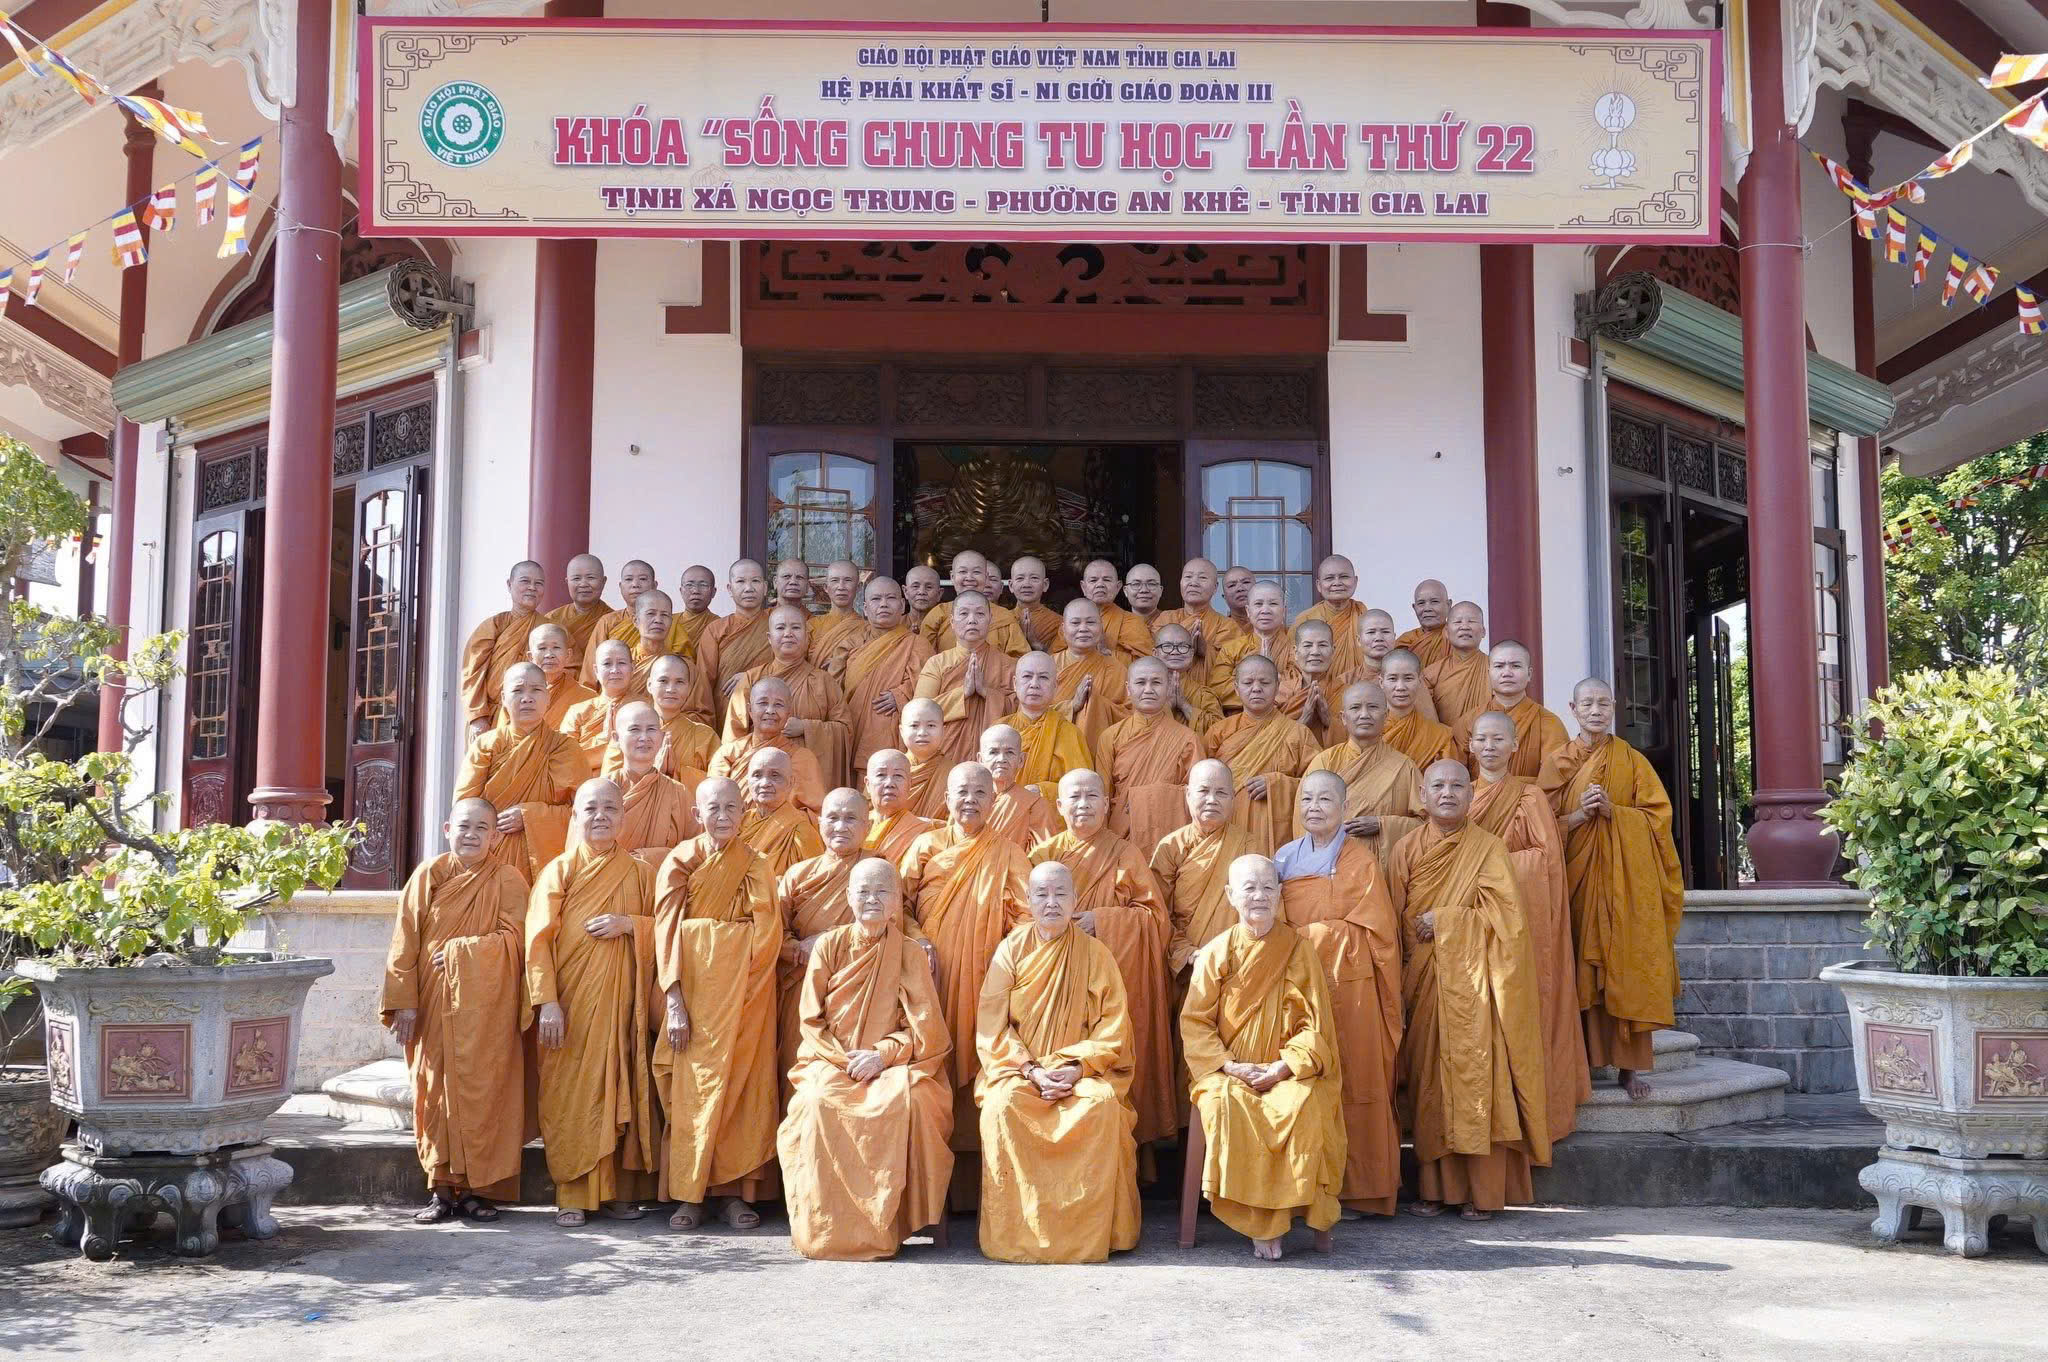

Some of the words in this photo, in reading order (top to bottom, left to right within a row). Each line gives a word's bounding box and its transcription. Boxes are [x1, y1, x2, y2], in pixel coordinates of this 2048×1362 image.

[858, 44, 898, 65] GIÁO
[904, 45, 934, 69] HỘI
[939, 46, 985, 69] PHẬT
[992, 47, 1031, 66] GIÁO
[1037, 46, 1077, 70] VIỆT
[1083, 50, 1120, 66] NAM
[1126, 44, 1168, 66] TỈNH
[1173, 50, 1202, 67] GIA
[1208, 51, 1235, 67] LAI
[821, 77, 851, 102] HỆ
[860, 77, 913, 98] PHÁI
[921, 75, 983, 99] KHẤT
[991, 79, 1014, 99] SĨ
[1036, 83, 1059, 99] NI
[1067, 78, 1113, 100] GIỚI
[1121, 79, 1172, 100] GIÁO
[1180, 80, 1240, 101] ĐOÀN
[1248, 84, 1272, 101] III
[423, 101, 437, 127] GIÁO
[437, 87, 456, 101] HỘI
[458, 85, 488, 101] PHẬT
[487, 101, 501, 127] GIÁO
[554, 104, 689, 165] KHÓA
[863, 121, 1024, 168] CHUNG
[1039, 121, 1106, 168] TU
[1247, 99, 1347, 170] LẦN
[1361, 111, 1467, 171] THỨ
[1476, 125, 1534, 171] 22
[436, 146, 461, 163] VIỆT
[465, 147, 489, 162] NAM
[602, 187, 683, 215] TỊNH
[693, 182, 736, 210] XÁ
[748, 188, 833, 216] NGỌC
[844, 190, 954, 212] TRUNG
[988, 184, 1117, 213] PHƯỜNG
[1127, 191, 1171, 213] AN
[1183, 186, 1249, 213] KHÊ
[1281, 185, 1360, 214] TỈNH
[1371, 193, 1425, 214] GIA
[1435, 193, 1488, 215] LAI
